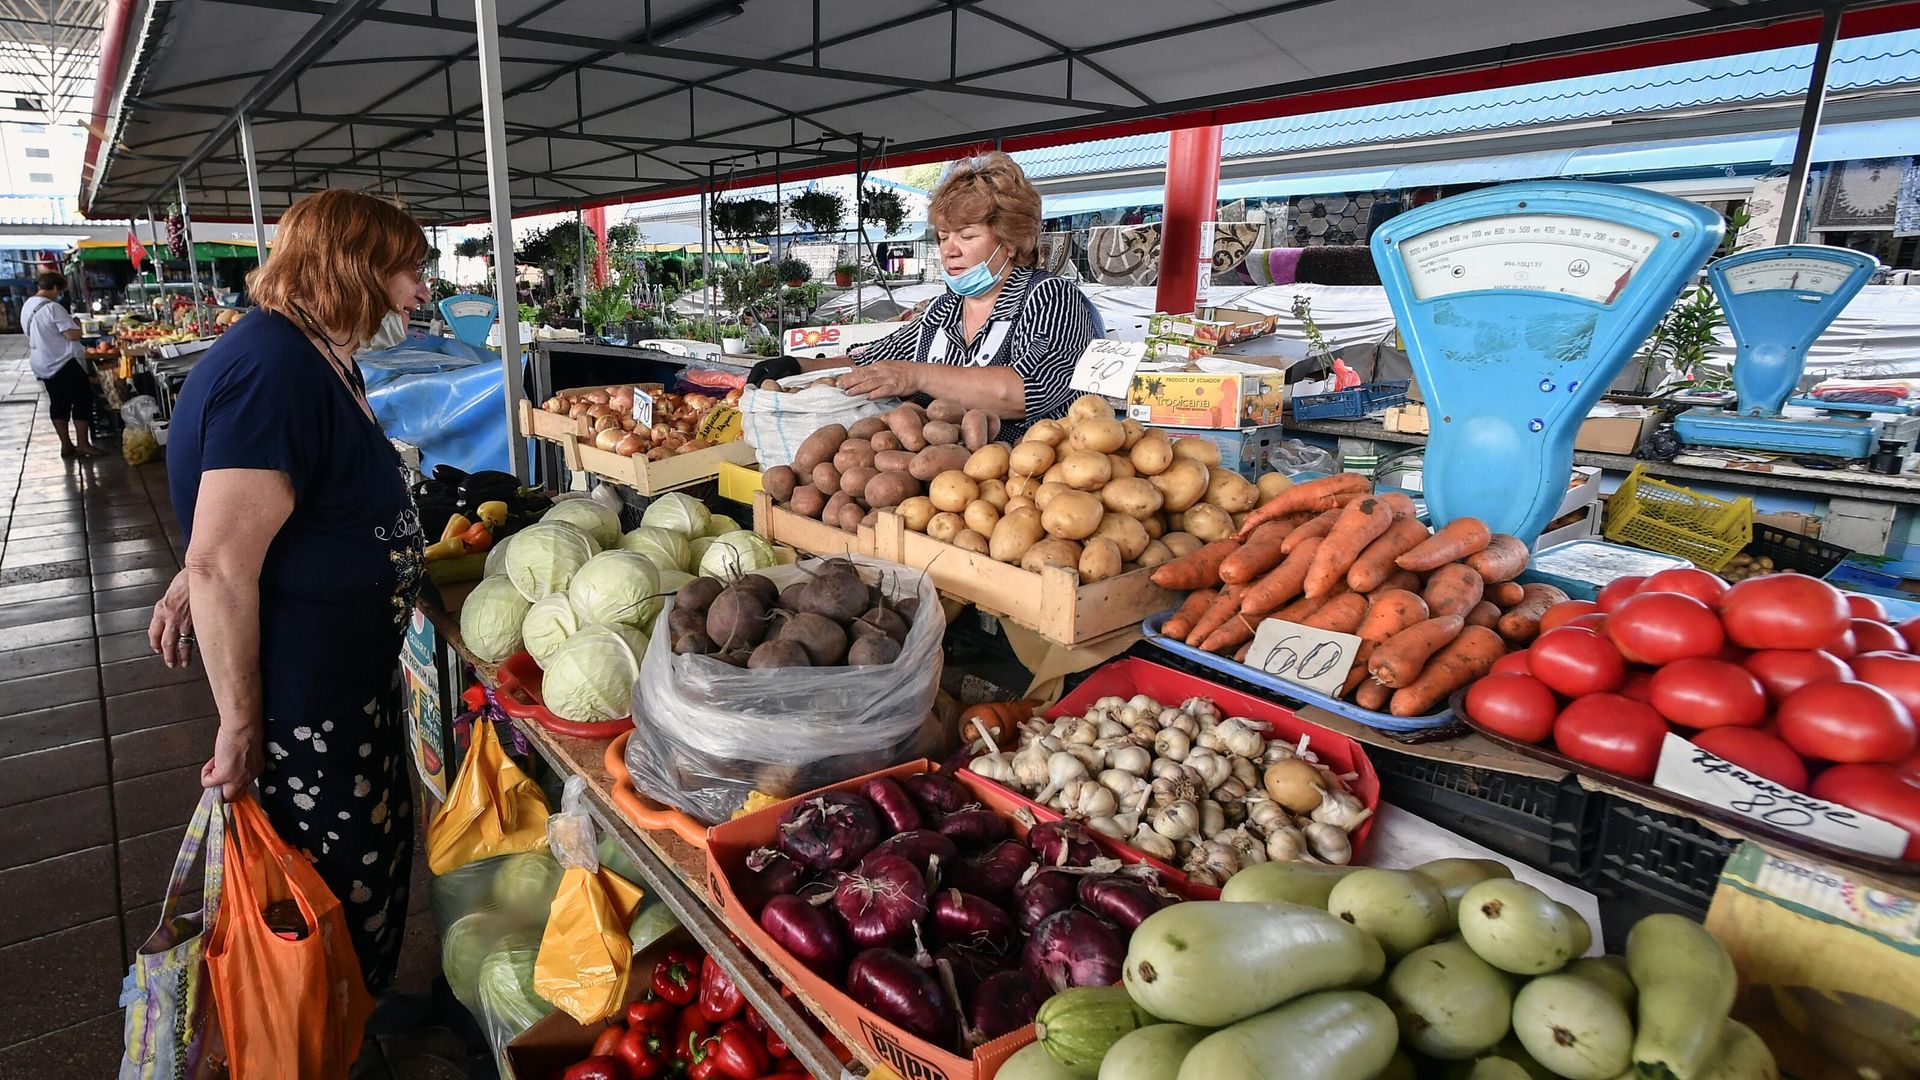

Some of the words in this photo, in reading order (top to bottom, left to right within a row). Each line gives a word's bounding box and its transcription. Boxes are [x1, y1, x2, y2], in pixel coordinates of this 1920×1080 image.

[1429, 241, 1439, 249] 900
[1450, 235, 1460, 243] 800
[1471, 230, 1481, 238] 700
[1494, 227, 1505, 235] 600
[1569, 228, 1580, 236] 300
[1593, 232, 1606, 241] 200
[1619, 238, 1630, 247] 100
[790, 327, 841, 347] Dole
[1090, 358, 1124, 380] 40
[1156, 395, 1210, 413] Tropicana
[1263, 636, 1342, 680] 60
[1731, 794, 1814, 827] 80
